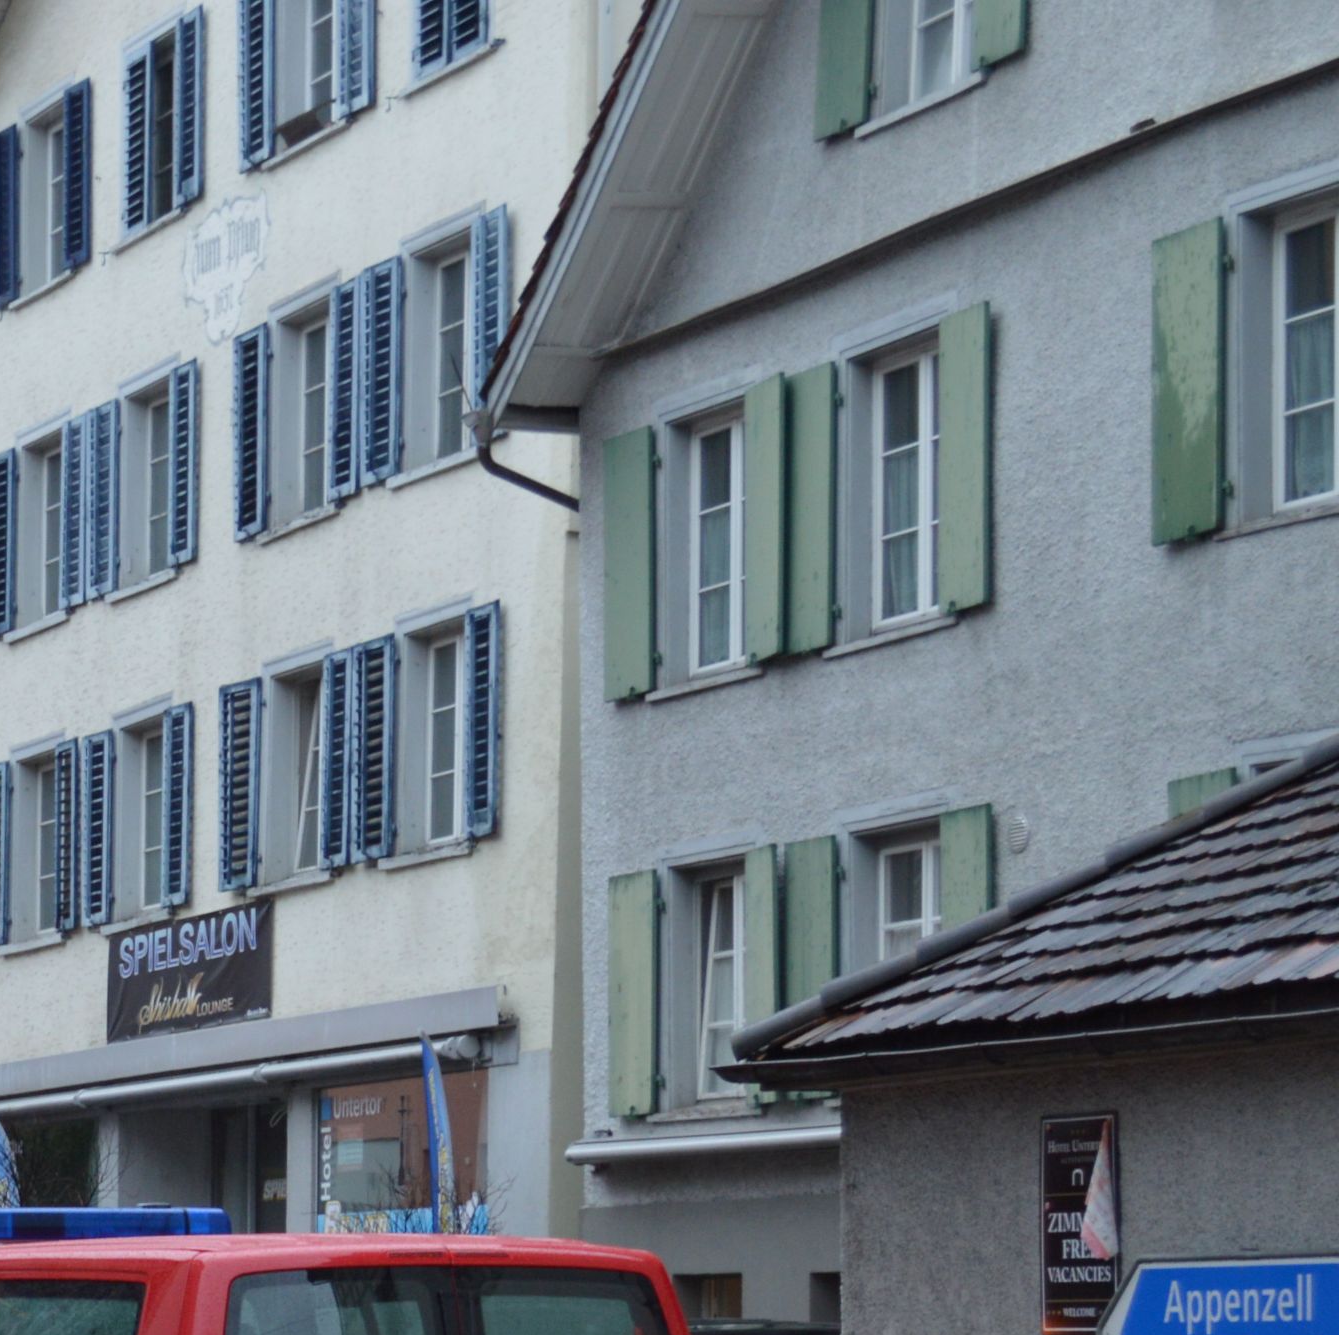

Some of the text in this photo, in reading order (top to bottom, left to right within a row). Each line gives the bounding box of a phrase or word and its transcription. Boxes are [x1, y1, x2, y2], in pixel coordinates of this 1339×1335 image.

[119, 907, 257, 979] SPIELSALON
[196, 997, 234, 1017] LOUNGE
[333, 1096, 383, 1119] Untertor
[321, 1126, 332, 1202] Hotel
[1048, 1266, 1112, 1283] VACANCIES
[1163, 1273, 1313, 1335] Appenzell
